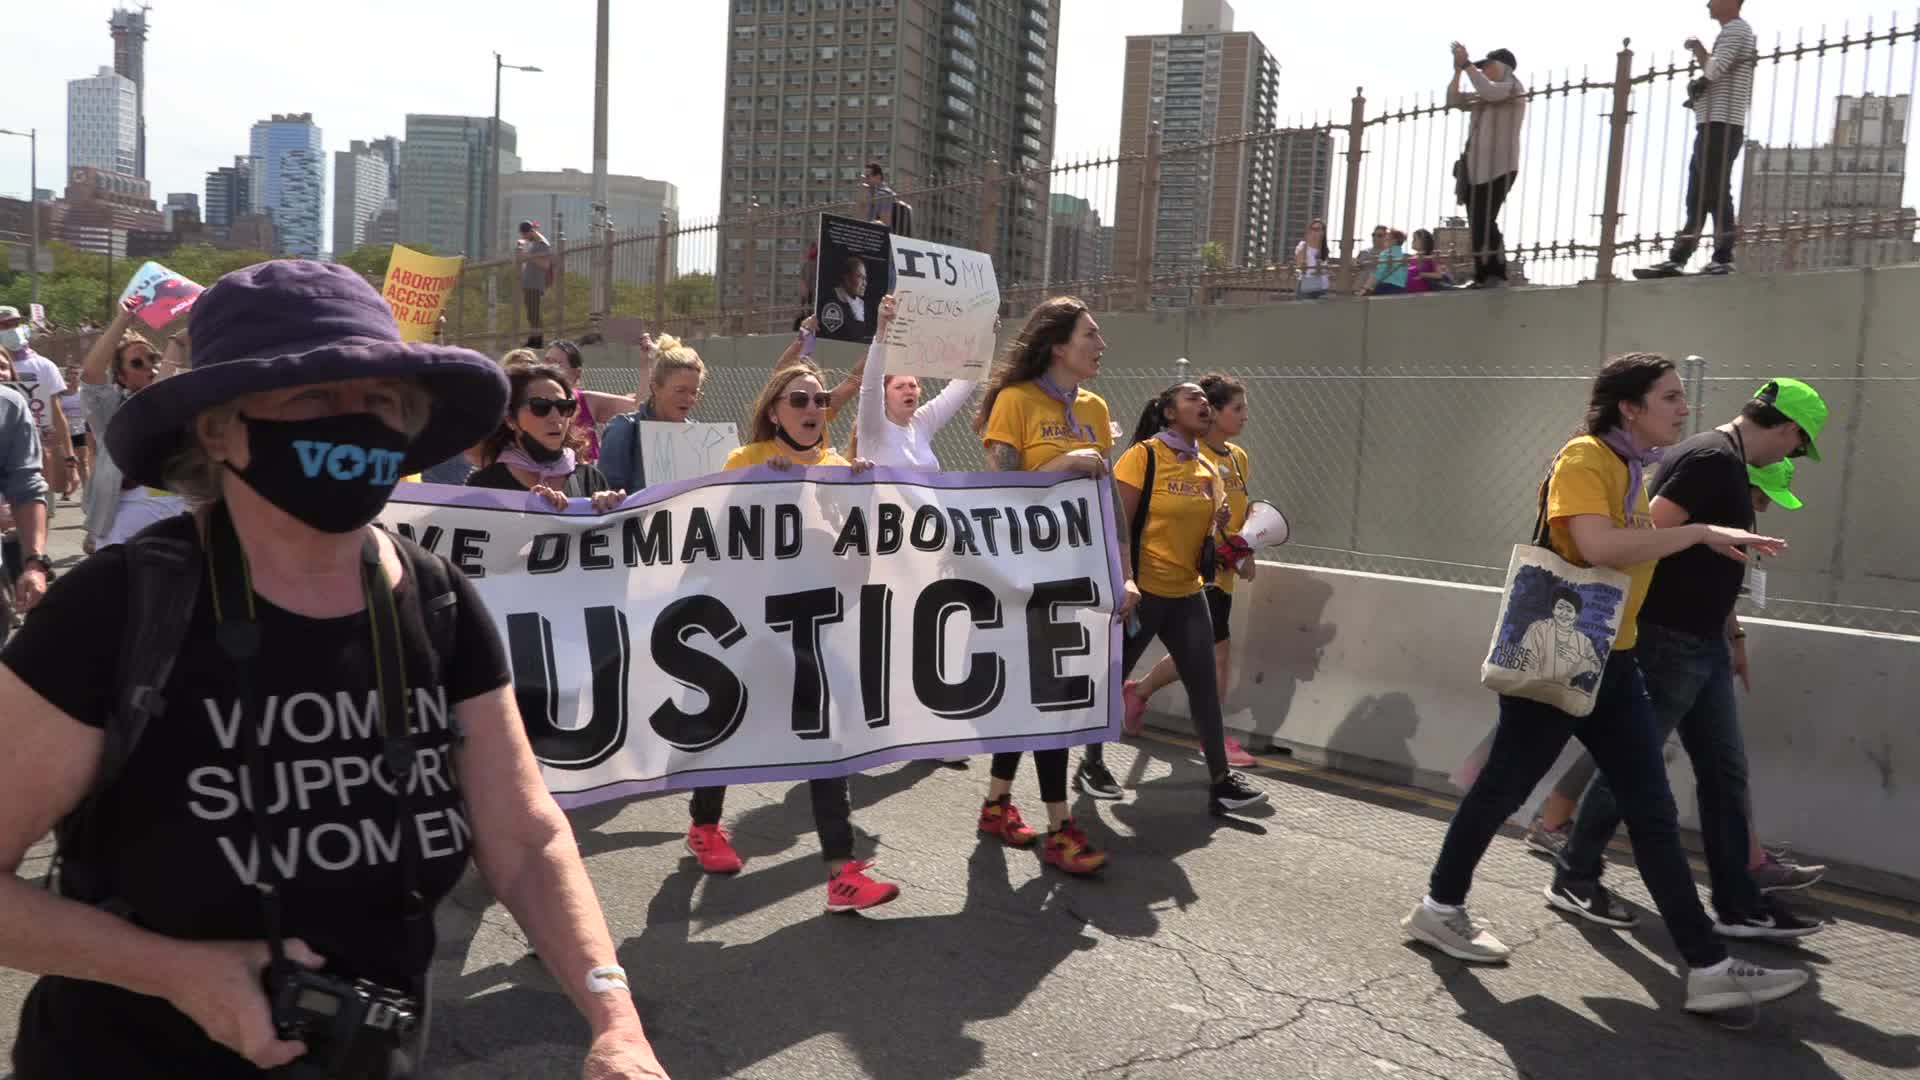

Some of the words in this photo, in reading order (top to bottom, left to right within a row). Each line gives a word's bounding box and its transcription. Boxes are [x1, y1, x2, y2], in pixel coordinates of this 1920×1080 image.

[896, 247, 958, 287] ITS
[961, 258, 985, 288] MY
[387, 283, 440, 308] ACCESS
[391, 302, 409, 321] OR
[412, 308, 433, 325] ALL
[896, 290, 963, 318] FUCKING
[291, 440, 406, 486] VOTE
[527, 503, 803, 575] DEMAND
[832, 497, 1093, 557] ABORTION
[1496, 641, 1532, 660] AUDRE
[506, 576, 1101, 770] USTICE
[187, 744, 452, 821] SUPPOR
